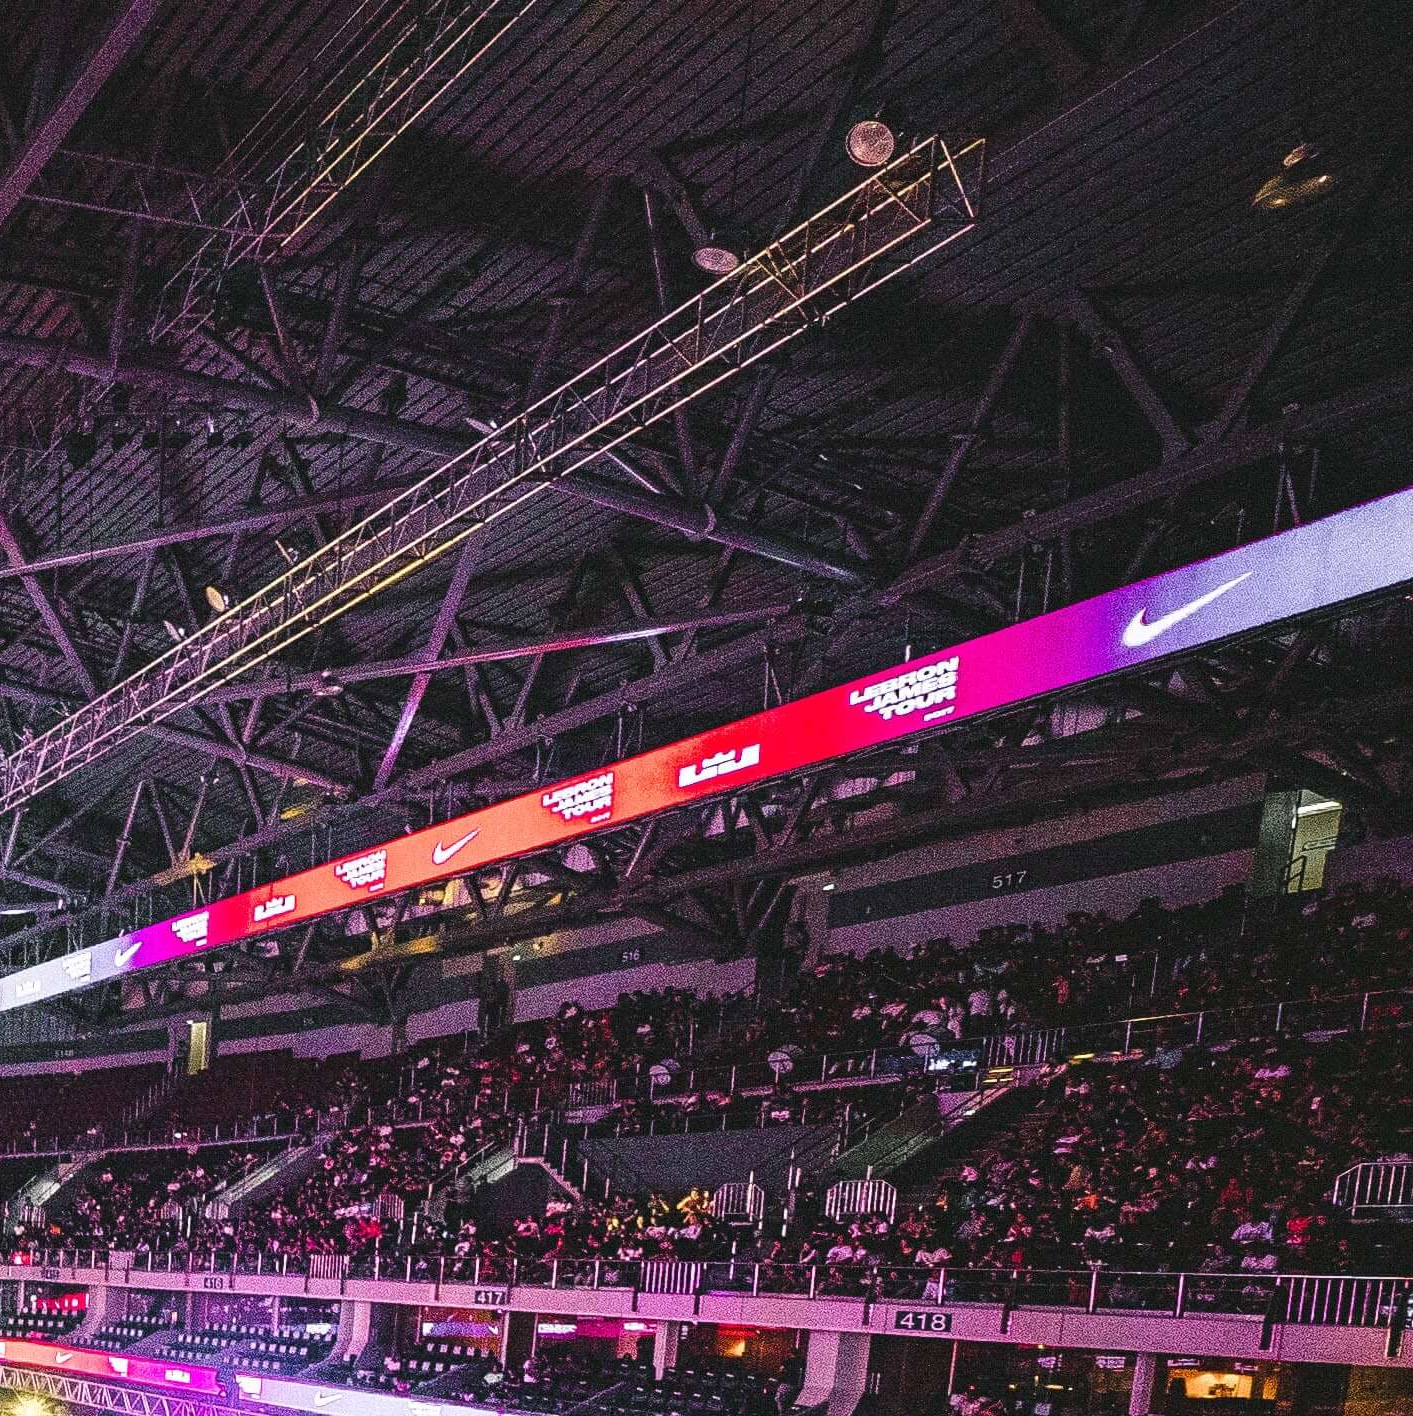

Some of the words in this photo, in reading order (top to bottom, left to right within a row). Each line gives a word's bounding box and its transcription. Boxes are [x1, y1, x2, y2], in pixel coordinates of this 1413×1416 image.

[850, 656, 959, 706] LEBRON
[864, 671, 958, 713] JAMES
[879, 686, 956, 720] TOUR
[542, 772, 613, 806] LEBRON
[561, 795, 611, 820] TOUR
[992, 870, 1027, 889] 517
[477, 1292, 503, 1304] 417
[900, 1313, 948, 1331] 418
